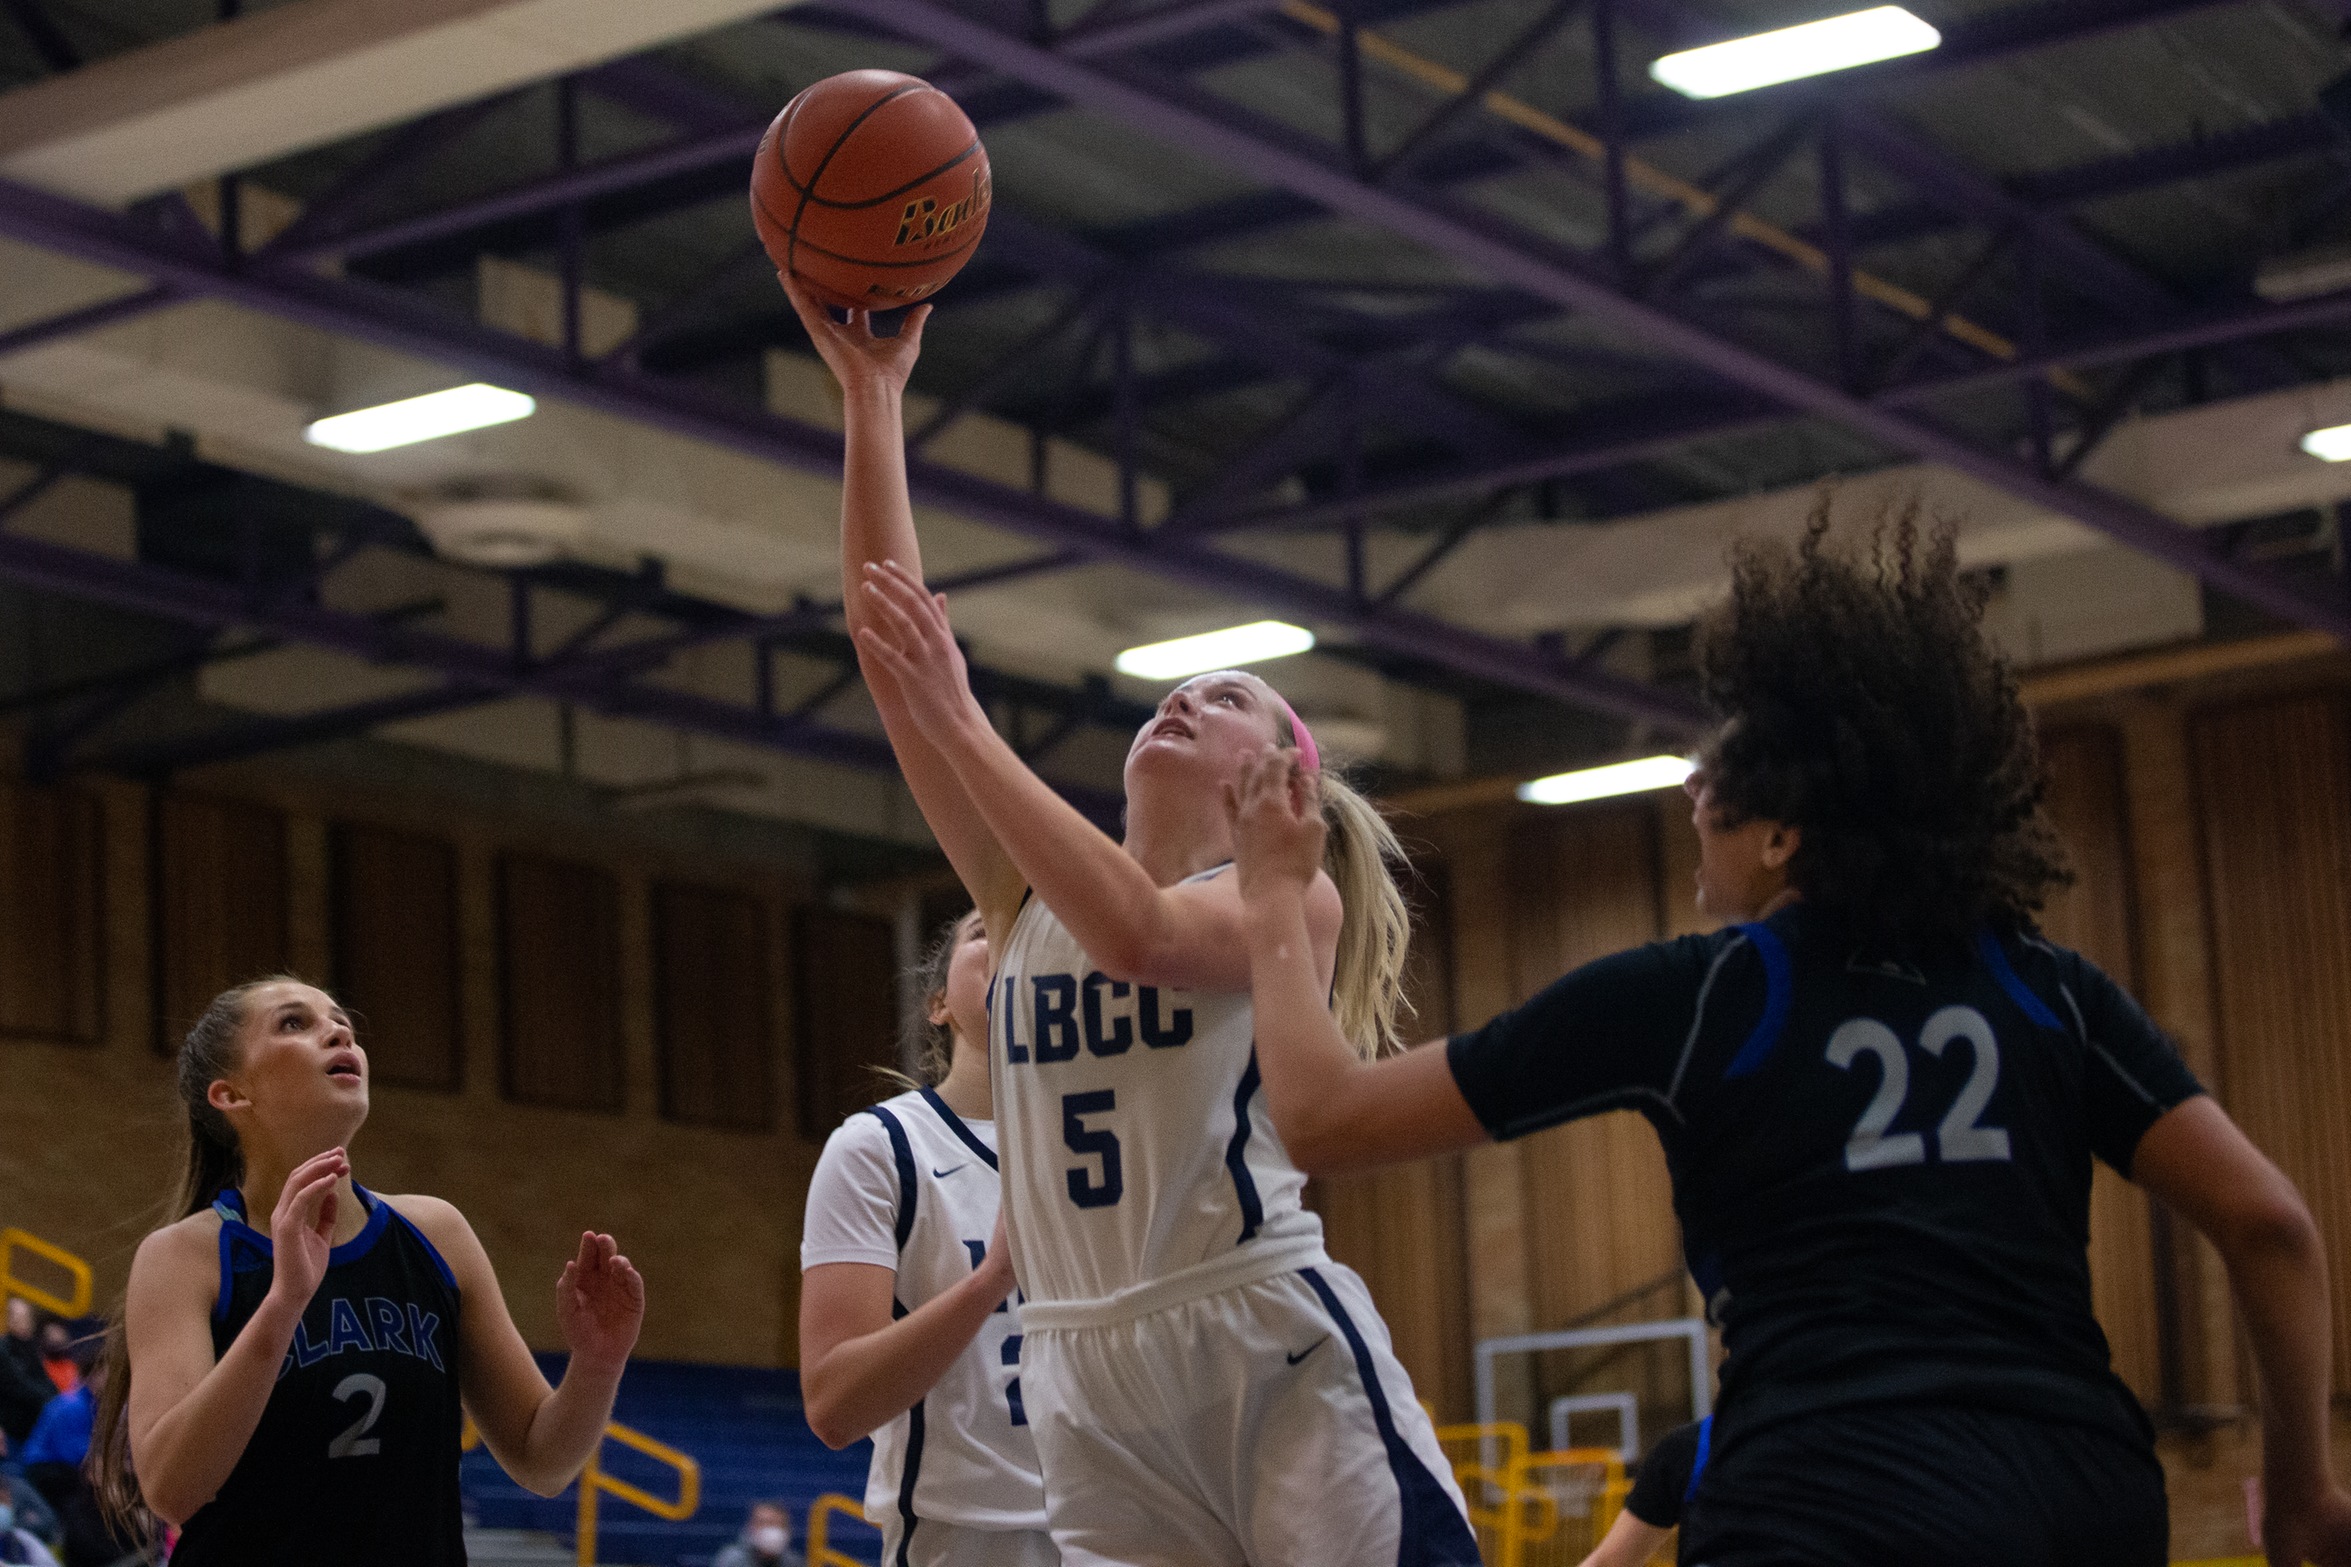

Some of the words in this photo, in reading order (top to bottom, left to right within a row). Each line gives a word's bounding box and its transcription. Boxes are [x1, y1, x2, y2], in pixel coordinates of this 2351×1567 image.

[1004, 970, 1194, 1065] LBCC
[1824, 1004, 2012, 1173] 22
[1061, 1088, 1124, 1211] 5
[277, 1297, 446, 1382] LARK
[328, 1373, 387, 1459] 2
